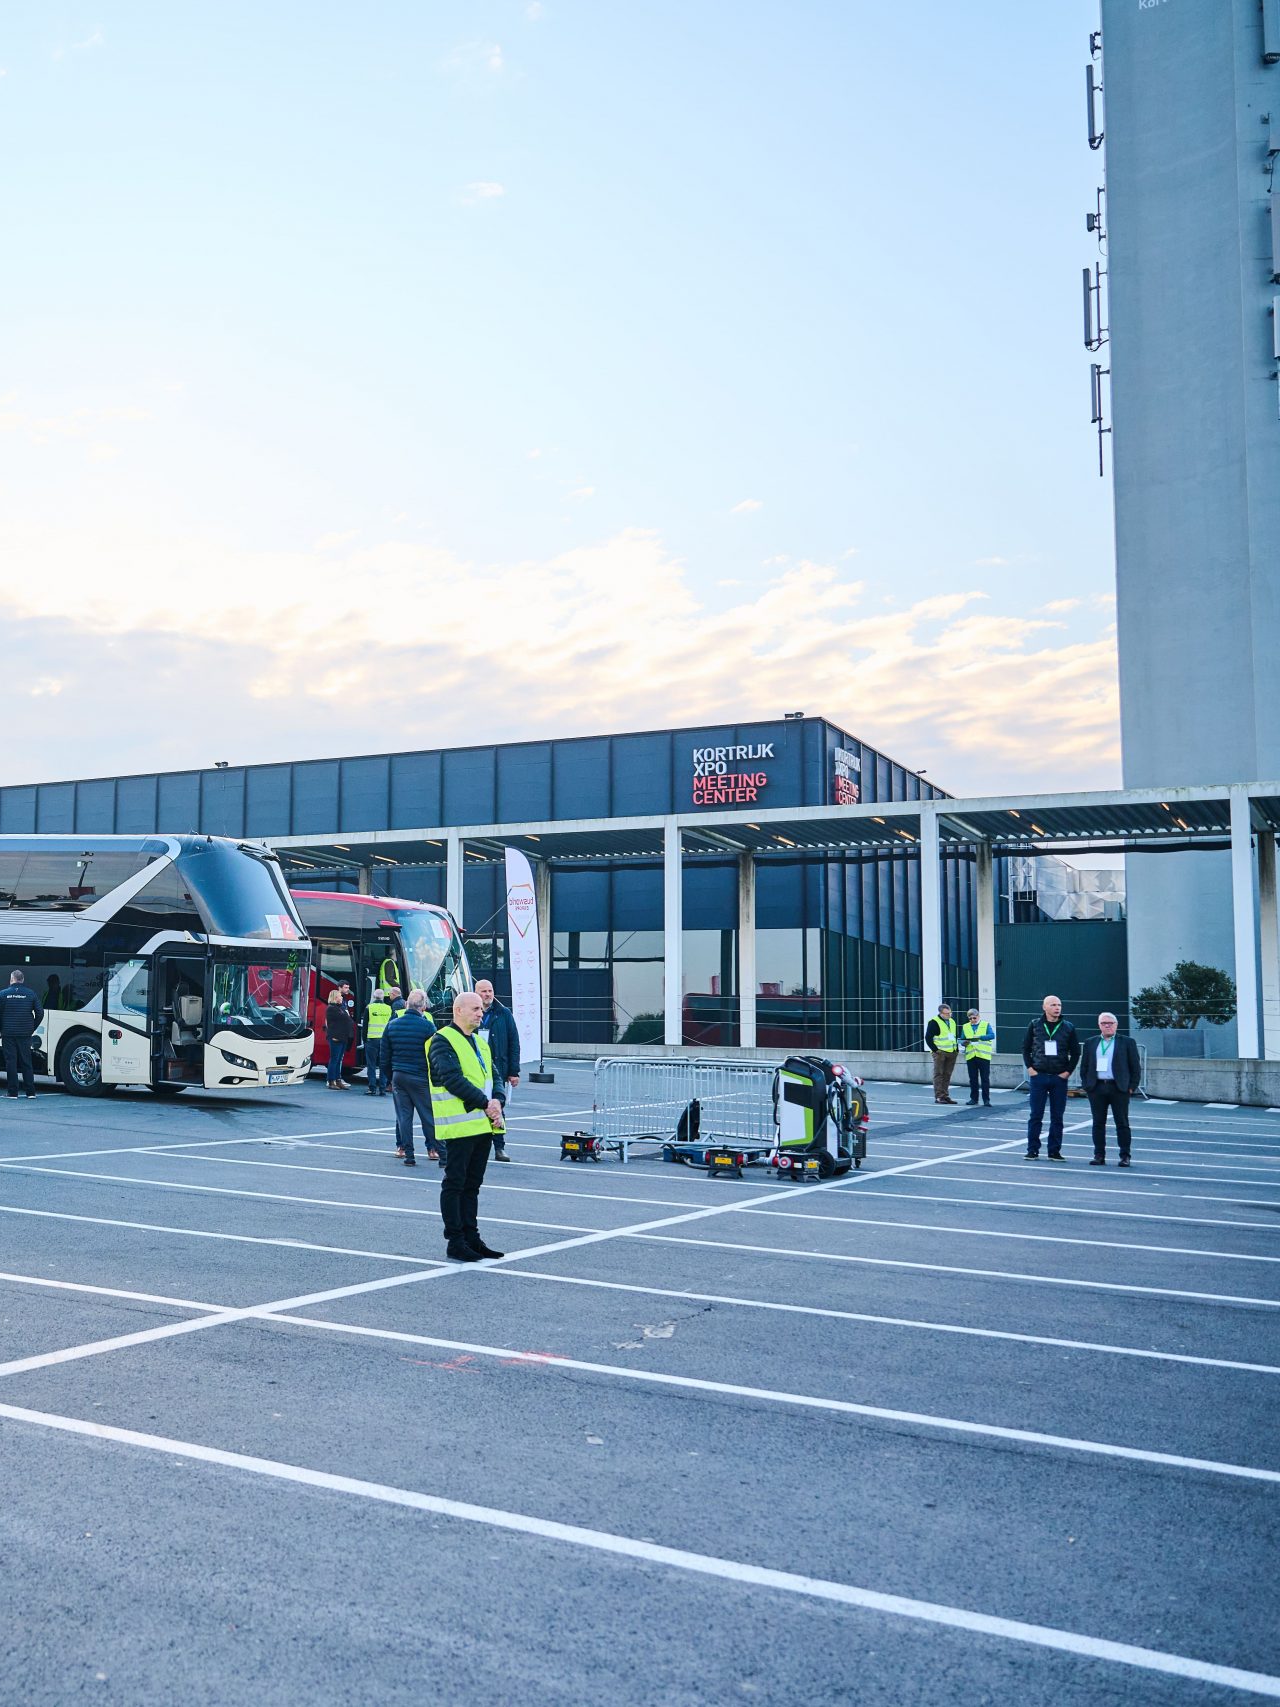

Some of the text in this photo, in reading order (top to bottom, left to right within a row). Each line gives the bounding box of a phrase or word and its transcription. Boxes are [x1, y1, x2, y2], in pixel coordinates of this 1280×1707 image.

[693, 743, 774, 763] KORTRIJK
[694, 761, 728, 777] XPO
[693, 772, 767, 791] MEETING
[693, 787, 758, 805] CENTER
